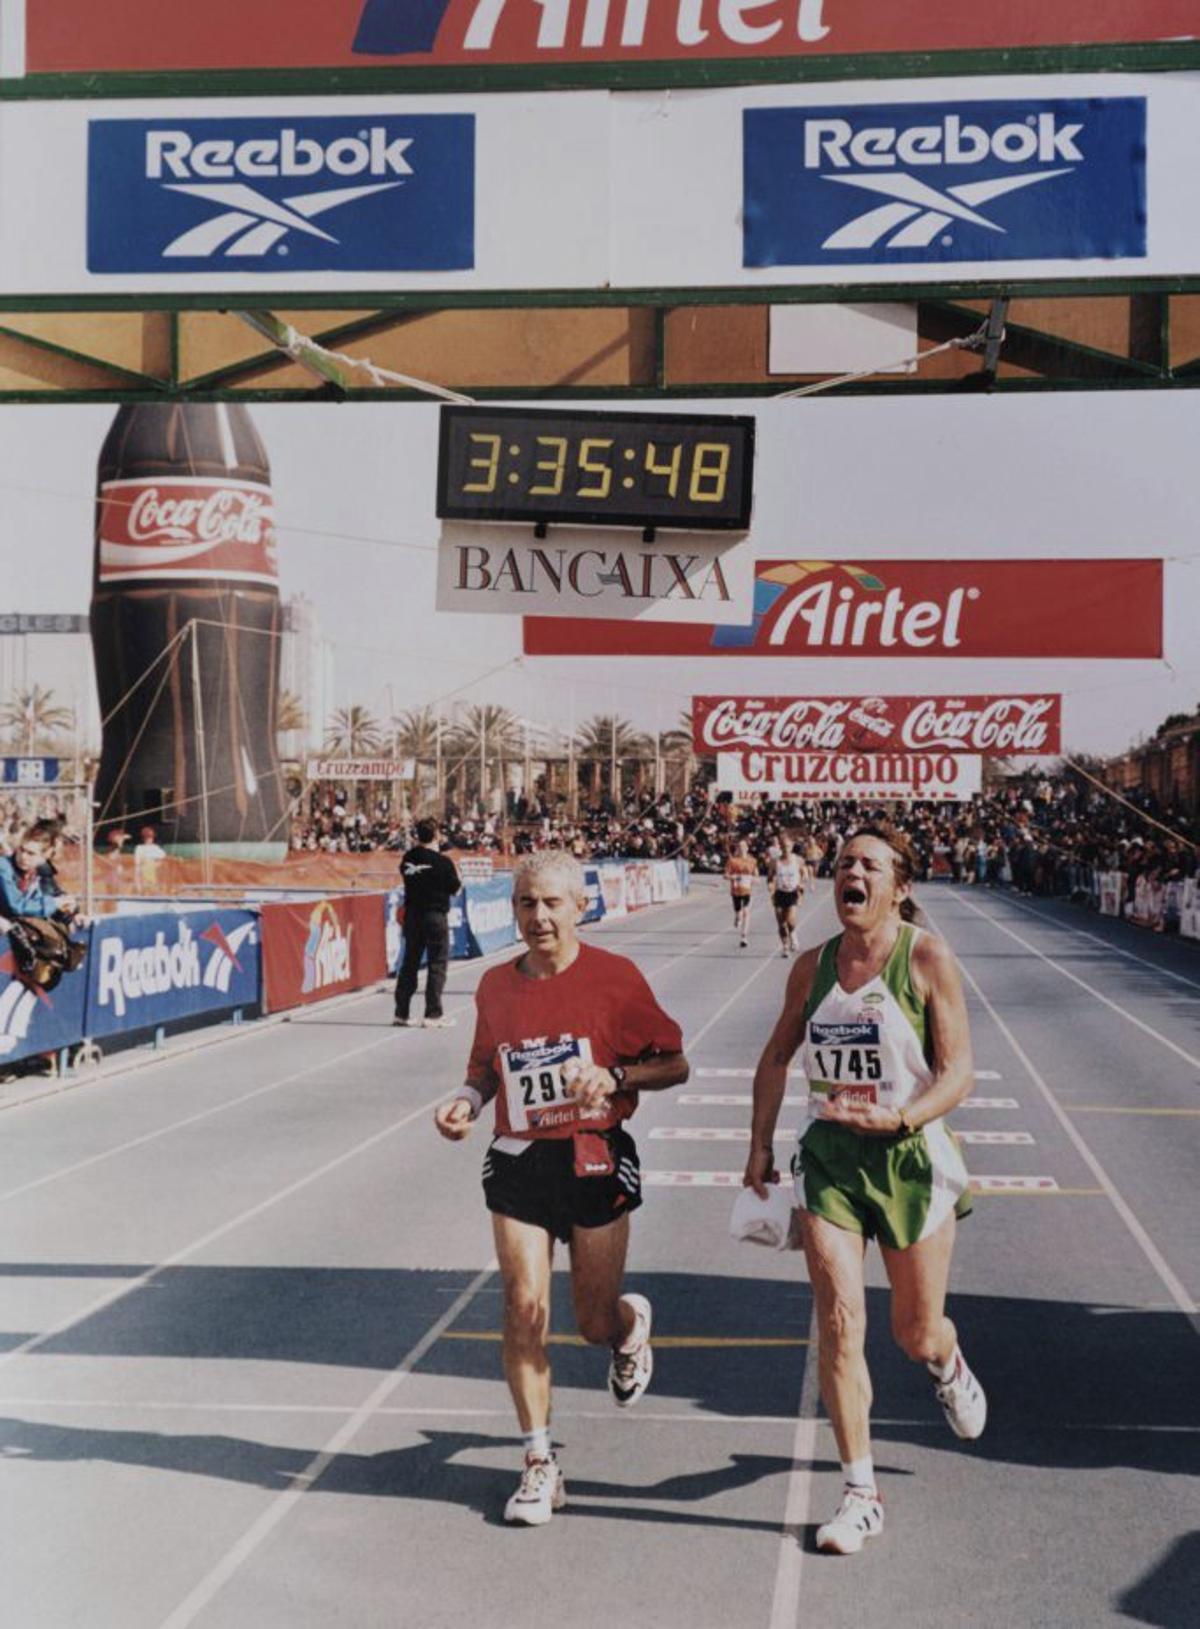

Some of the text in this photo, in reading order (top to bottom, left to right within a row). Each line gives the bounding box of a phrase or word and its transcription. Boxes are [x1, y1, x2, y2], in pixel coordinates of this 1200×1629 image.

[146, 127, 415, 179] Reebok
[804, 112, 1085, 169] Reebok
[463, 433, 731, 502] 3:35:48
[128, 488, 262, 543] Coca-Cola
[454, 545, 734, 602] BANCAIXA
[769, 581, 962, 648] Airtel
[703, 700, 852, 748] Coca-Cola
[902, 699, 1054, 749] Coca-Cola
[741, 752, 959, 790] Cruzcampo
[99, 920, 201, 1017] Reebok
[812, 1024, 874, 1037] Reebok
[814, 1049, 882, 1080] 1745
